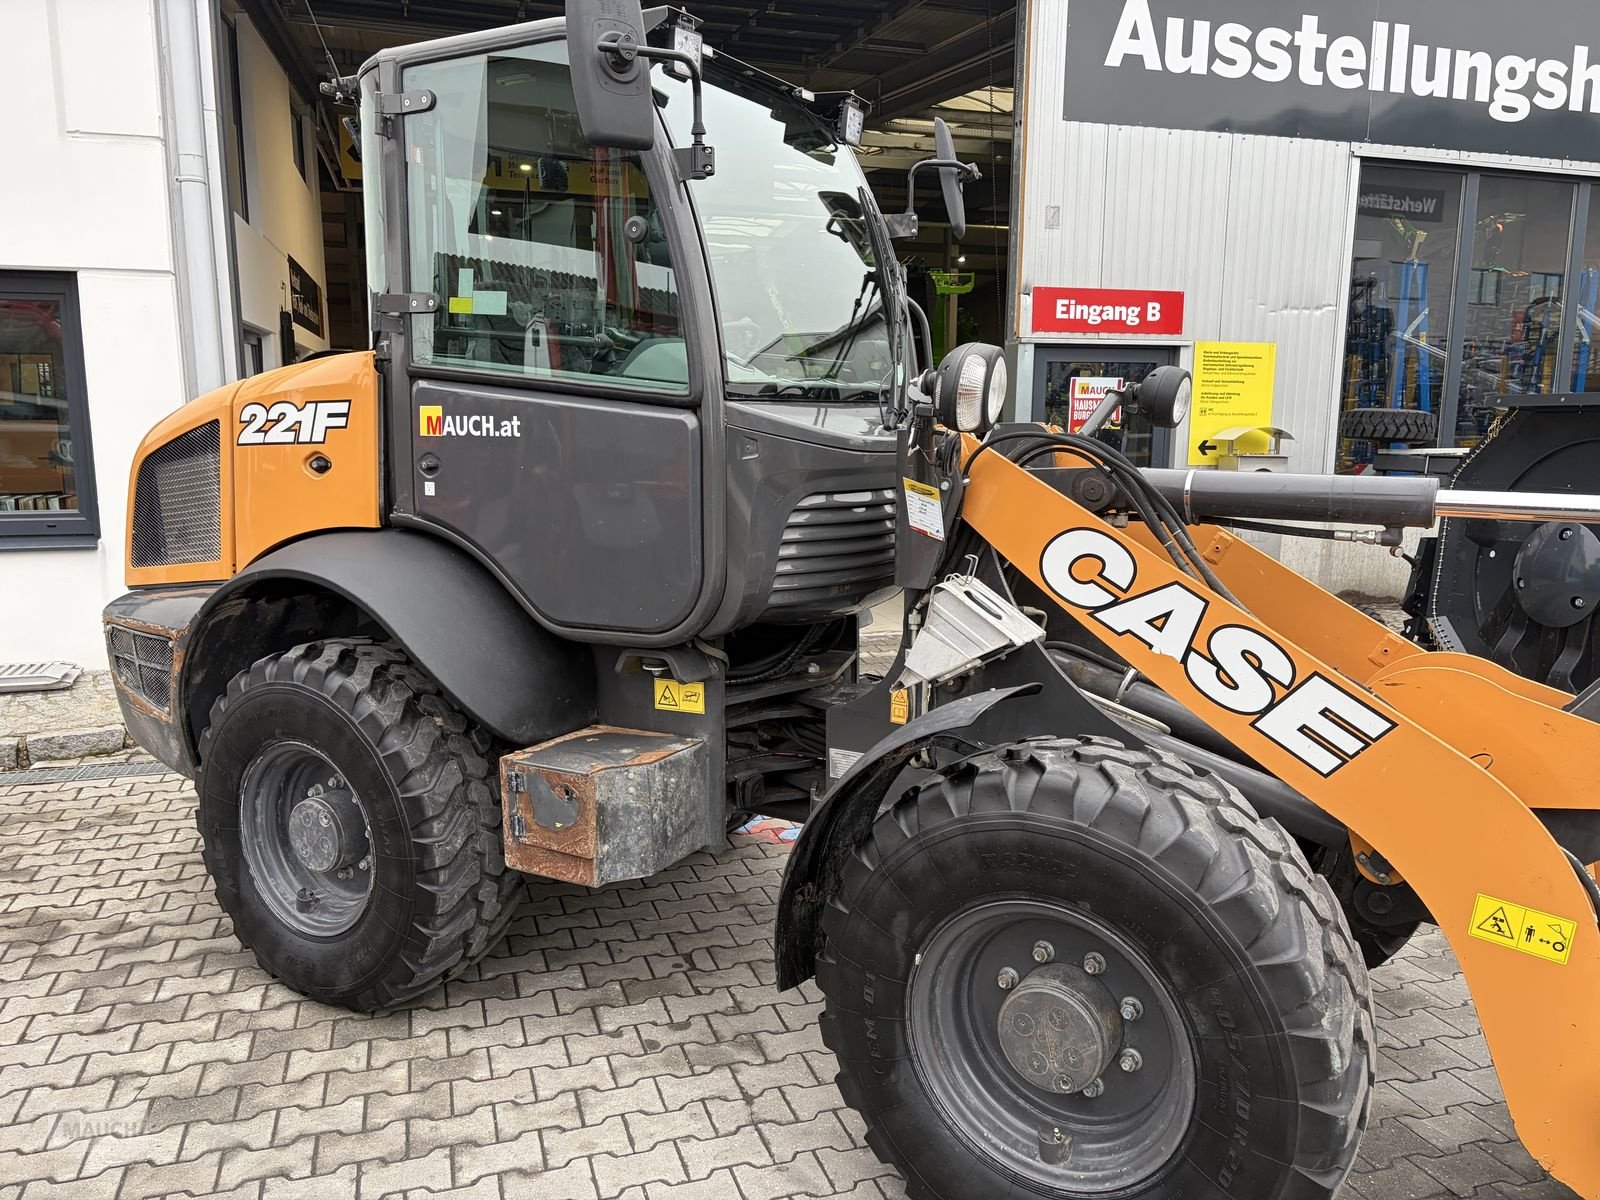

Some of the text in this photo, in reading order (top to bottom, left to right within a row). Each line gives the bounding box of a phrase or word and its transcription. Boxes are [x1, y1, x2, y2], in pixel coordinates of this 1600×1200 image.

[1056, 299, 1161, 326] Eingang B
[1081, 386, 1115, 395] MAUC
[237, 400, 352, 447] 221F
[426, 415, 521, 437] MAUCH.at
[1039, 526, 1399, 779] CASE
